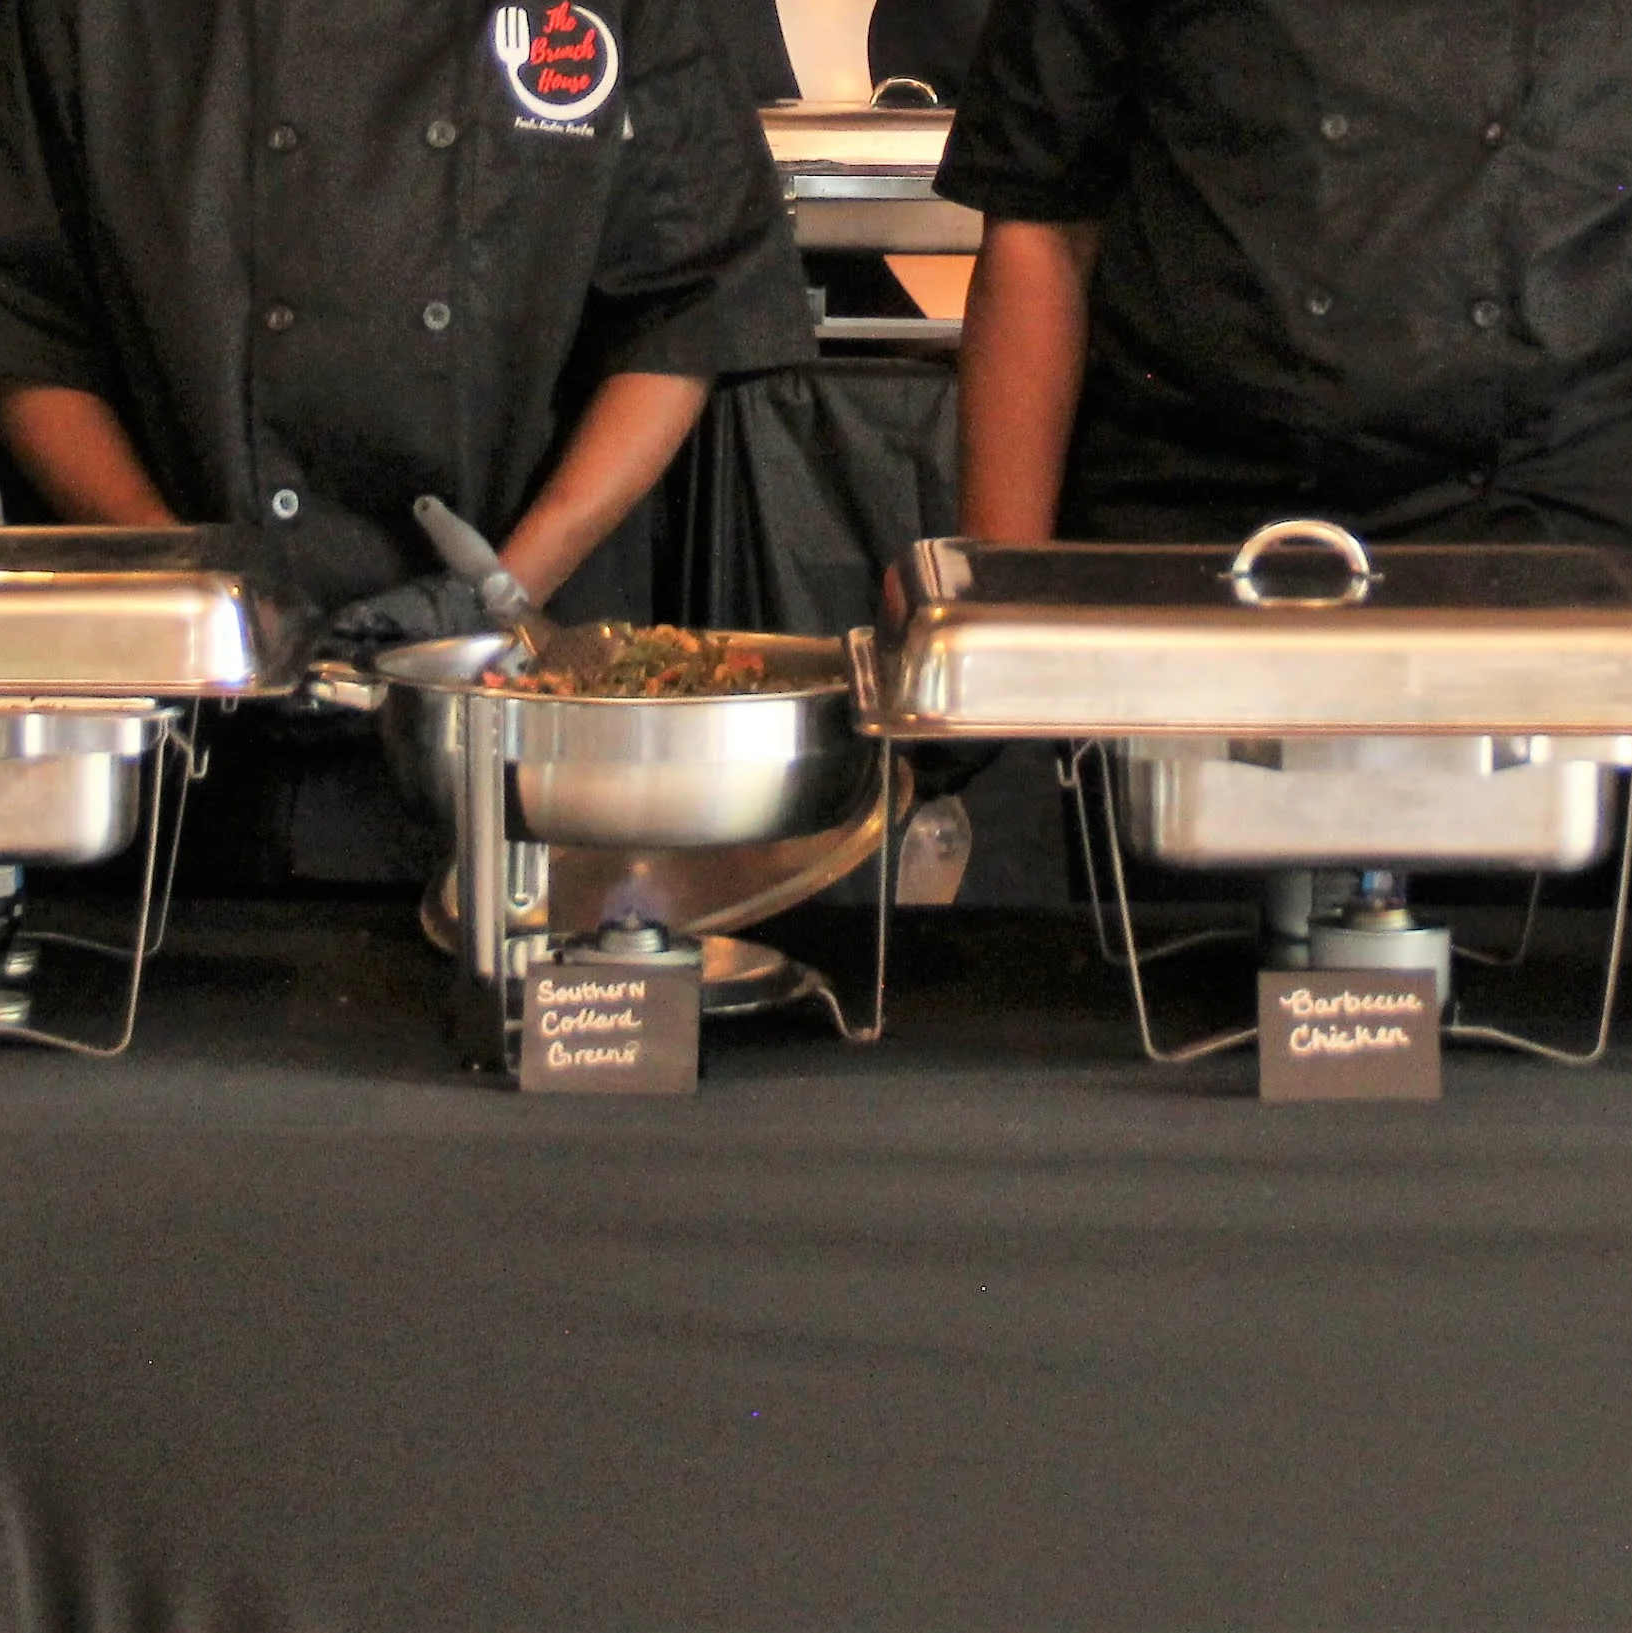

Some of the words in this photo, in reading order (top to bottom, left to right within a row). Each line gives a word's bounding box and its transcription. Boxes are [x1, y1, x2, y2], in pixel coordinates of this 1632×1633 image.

[542, 0, 579, 35] The
[529, 28, 597, 66] Brunch
[536, 67, 593, 95] House
[1278, 986, 1425, 1019] Barbecue
[540, 1008, 643, 1037] Collard
[547, 1039, 640, 1068] Greens
[1289, 1023, 1413, 1057] Chicken
